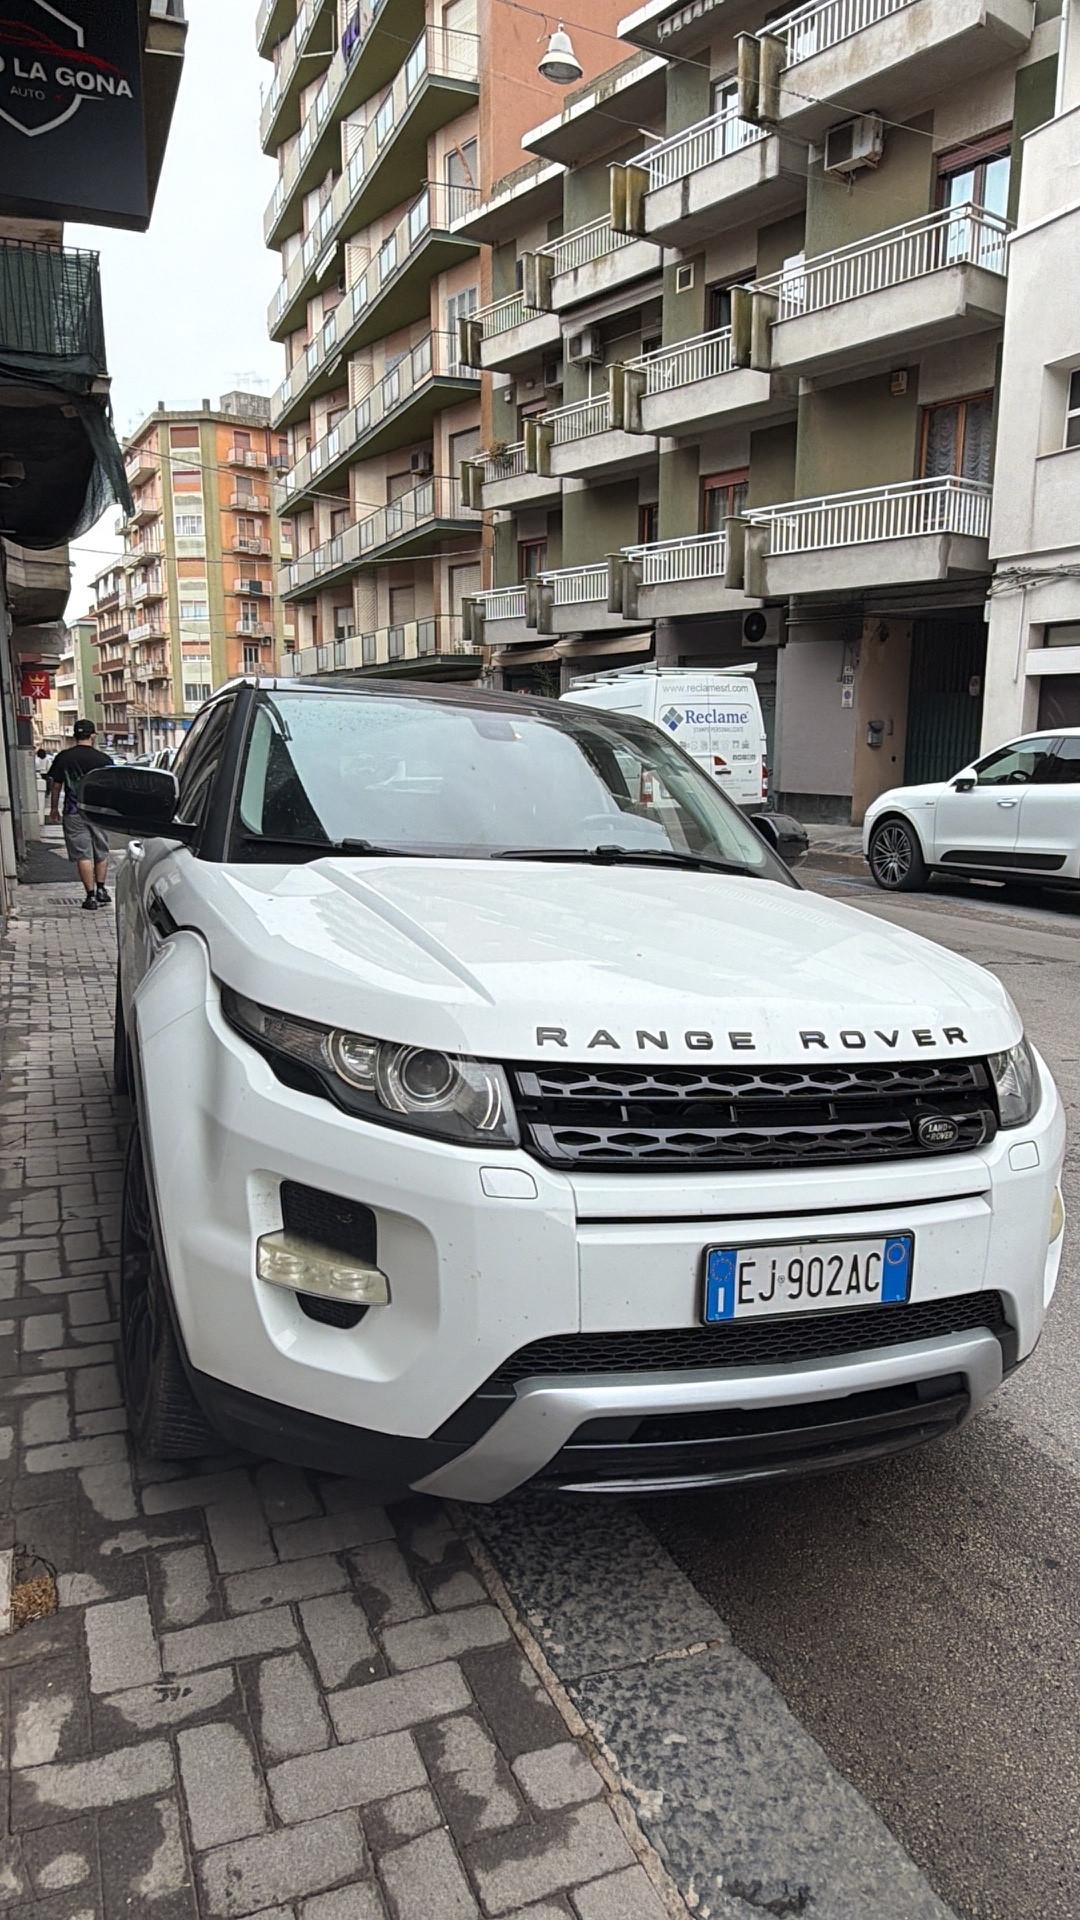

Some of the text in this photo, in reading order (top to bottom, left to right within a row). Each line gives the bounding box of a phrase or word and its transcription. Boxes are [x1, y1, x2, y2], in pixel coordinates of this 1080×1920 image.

[13, 57, 48, 82] LA
[55, 66, 133, 98] GONA
[10, 85, 46, 100] AUTO
[685, 709, 749, 724] Reclame
[536, 1026, 969, 1051] RANGE ROVER
[929, 1123, 947, 1132] LAND
[931, 1131, 953, 1140] ROVER
